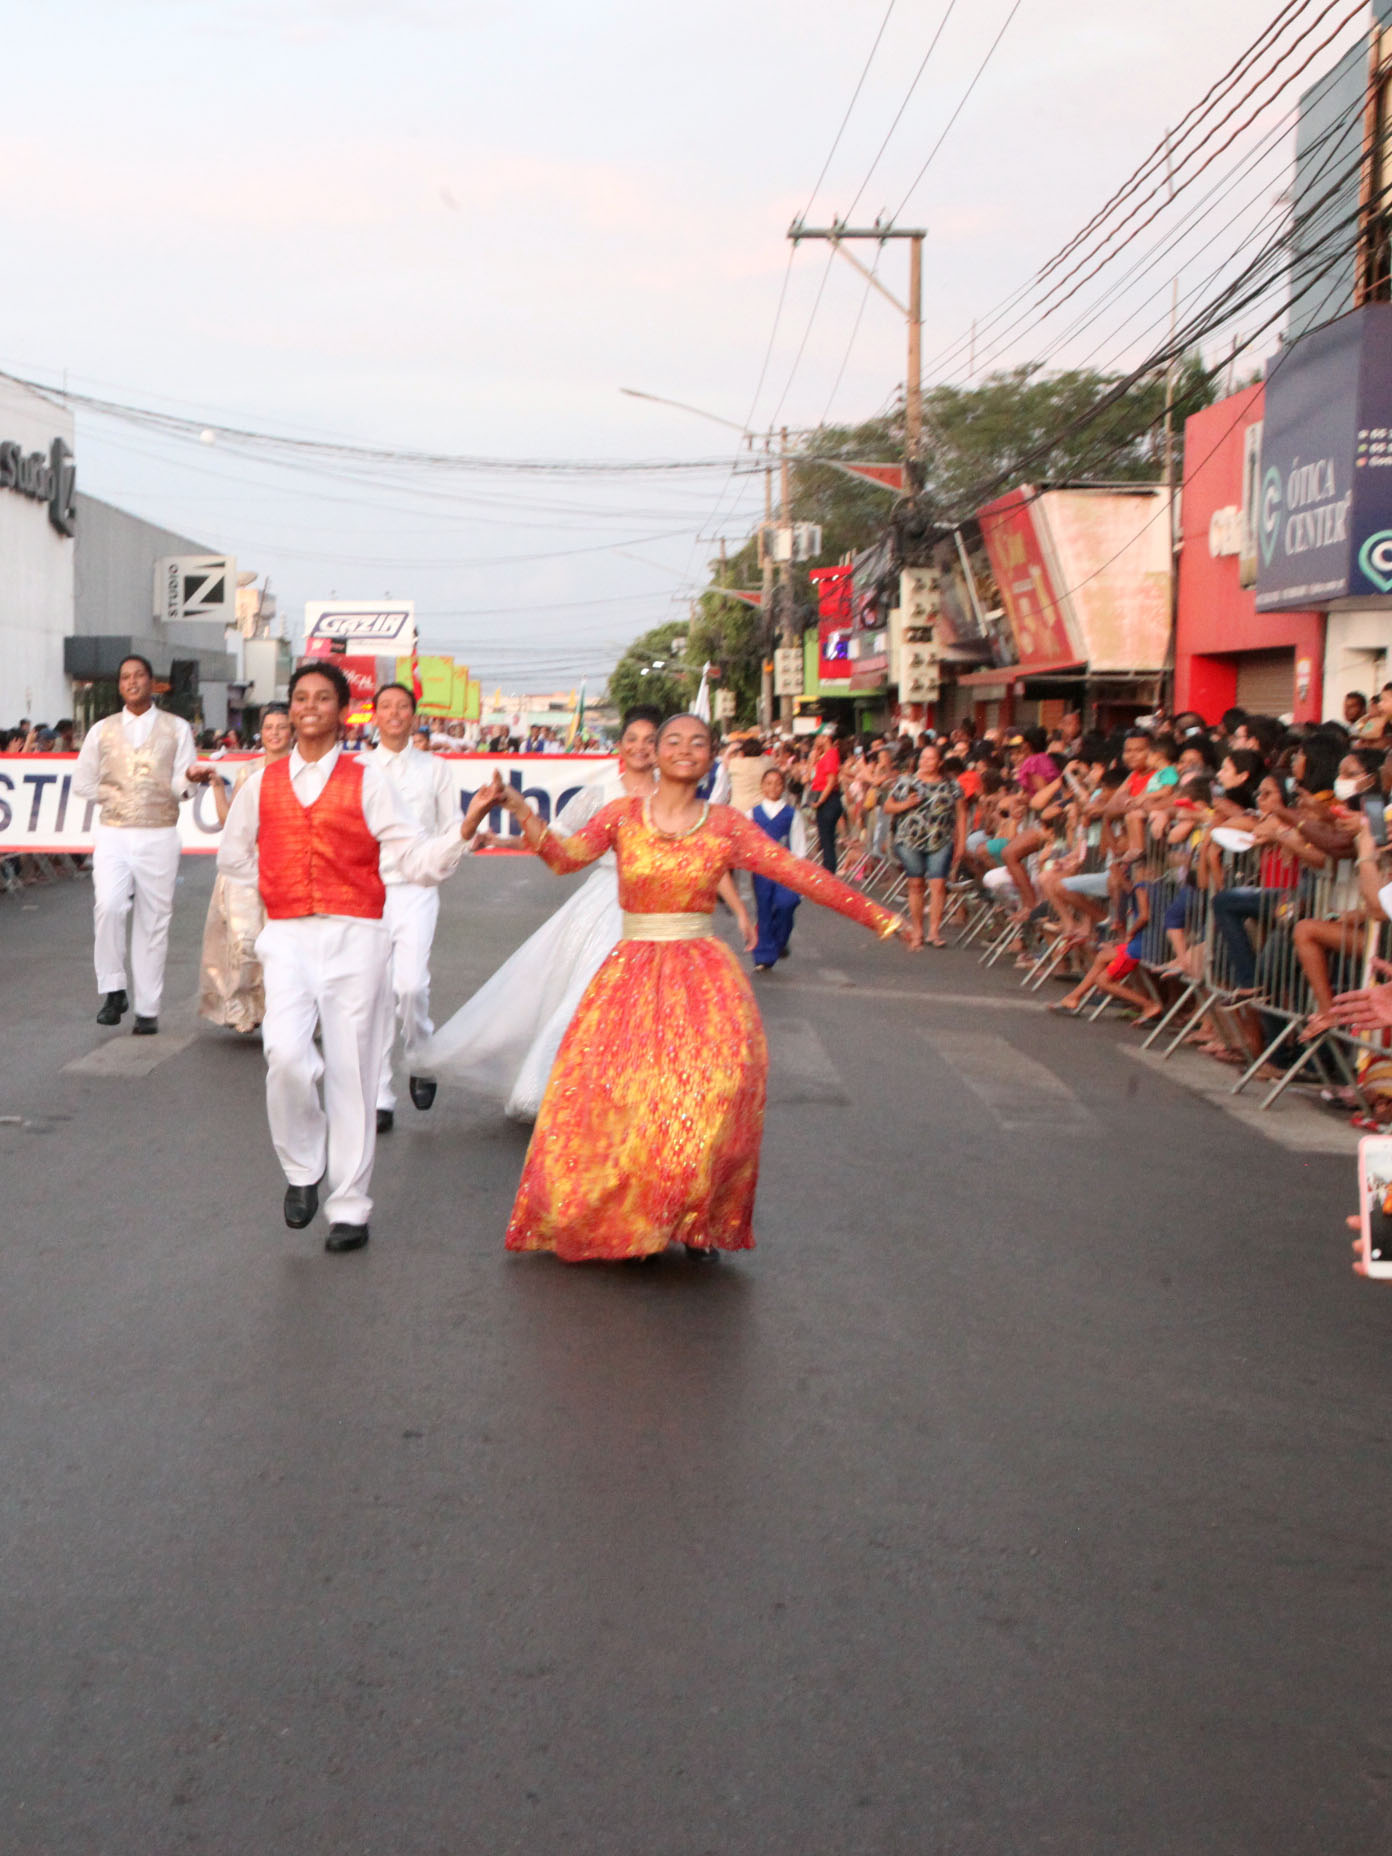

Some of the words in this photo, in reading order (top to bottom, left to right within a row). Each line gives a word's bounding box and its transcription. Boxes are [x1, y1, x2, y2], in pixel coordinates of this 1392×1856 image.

[1287, 456, 1336, 511] ÓTICA
[1285, 501, 1348, 556] CENTER
[168, 563, 179, 618] STUDIO
